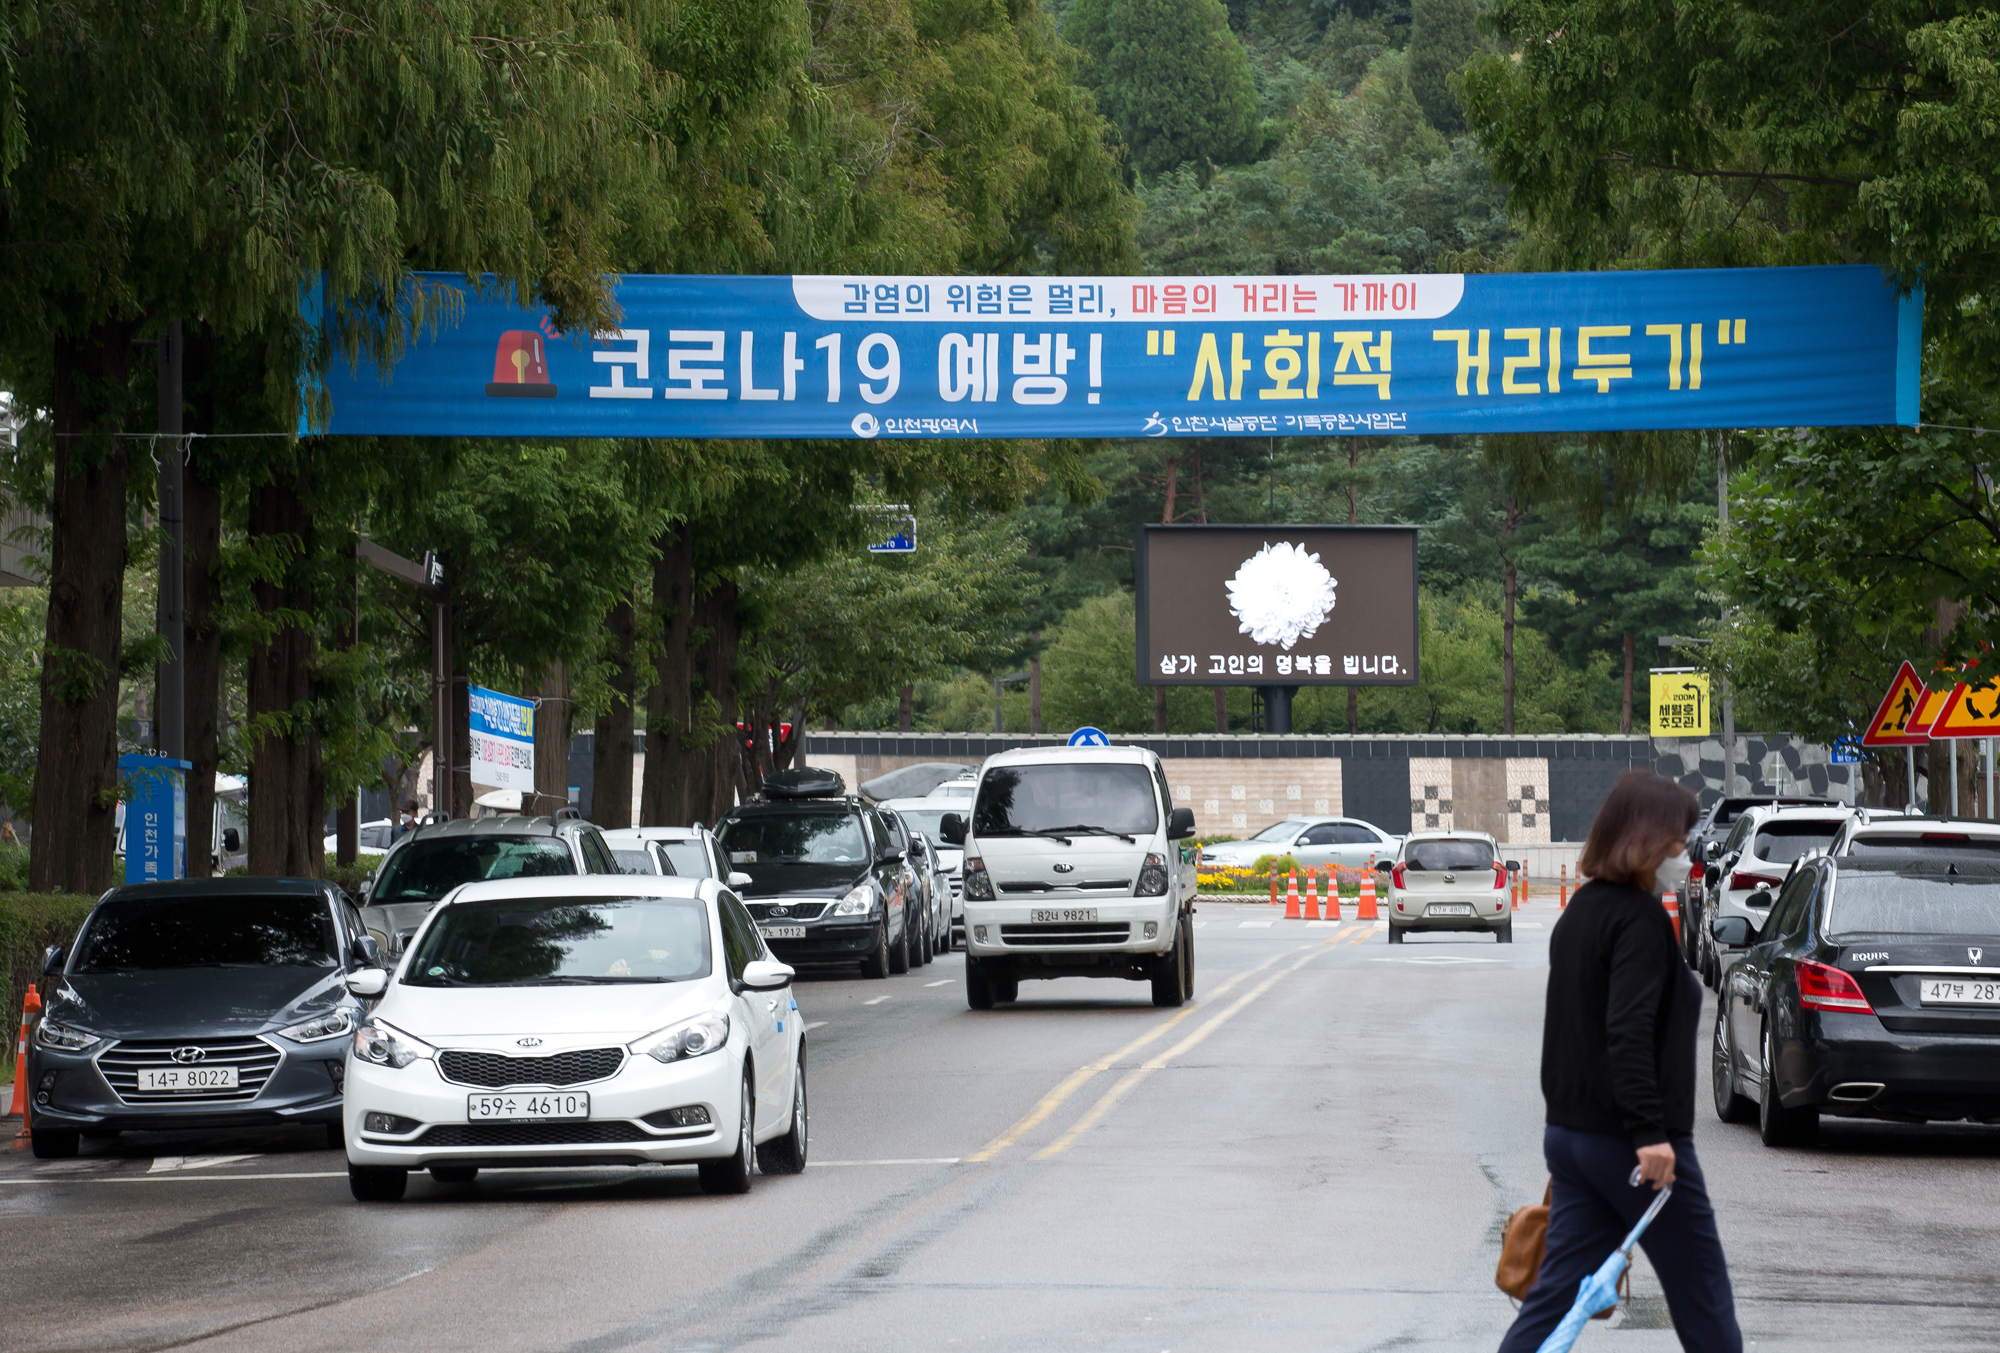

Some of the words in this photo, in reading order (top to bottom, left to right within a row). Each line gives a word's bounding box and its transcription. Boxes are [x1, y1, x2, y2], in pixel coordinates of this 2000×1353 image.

[843, 284, 930, 314] 감염의
[946, 283, 1033, 315] 위험은
[1048, 284, 1116, 318] 멀리,
[1132, 284, 1217, 314] 마음의
[1233, 283, 1318, 314] 거리는
[1333, 282, 1417, 312] 가까이
[589, 329, 901, 405] 코로나19
[938, 332, 1102, 405] 예방!
[1146, 329, 1392, 401] "사회적
[1432, 318, 1747, 397] 거리두기"
[885, 418, 979, 434] 인천광역시
[1171, 415, 1278, 432] 인천시설공단
[1284, 412, 1408, 431] 가족공원사업단
[1159, 654, 1198, 675] 삼가
[1208, 654, 1264, 675] 고인의
[1275, 654, 1332, 675] 명복을
[1343, 654, 1408, 675] 빕니다.
[1659, 704, 1694, 716] 세월호
[1659, 717, 1694, 729] 추모관
[1063, 911, 1090, 921] 9821
[778, 928, 801, 937] 1912
[1852, 952, 1889, 962] EQUUS
[1930, 982, 1964, 999] 47부
[148, 1072, 179, 1088] 14구
[187, 1070, 229, 1087] 8022
[480, 1098, 517, 1116] 59수
[527, 1096, 576, 1115] 4610
